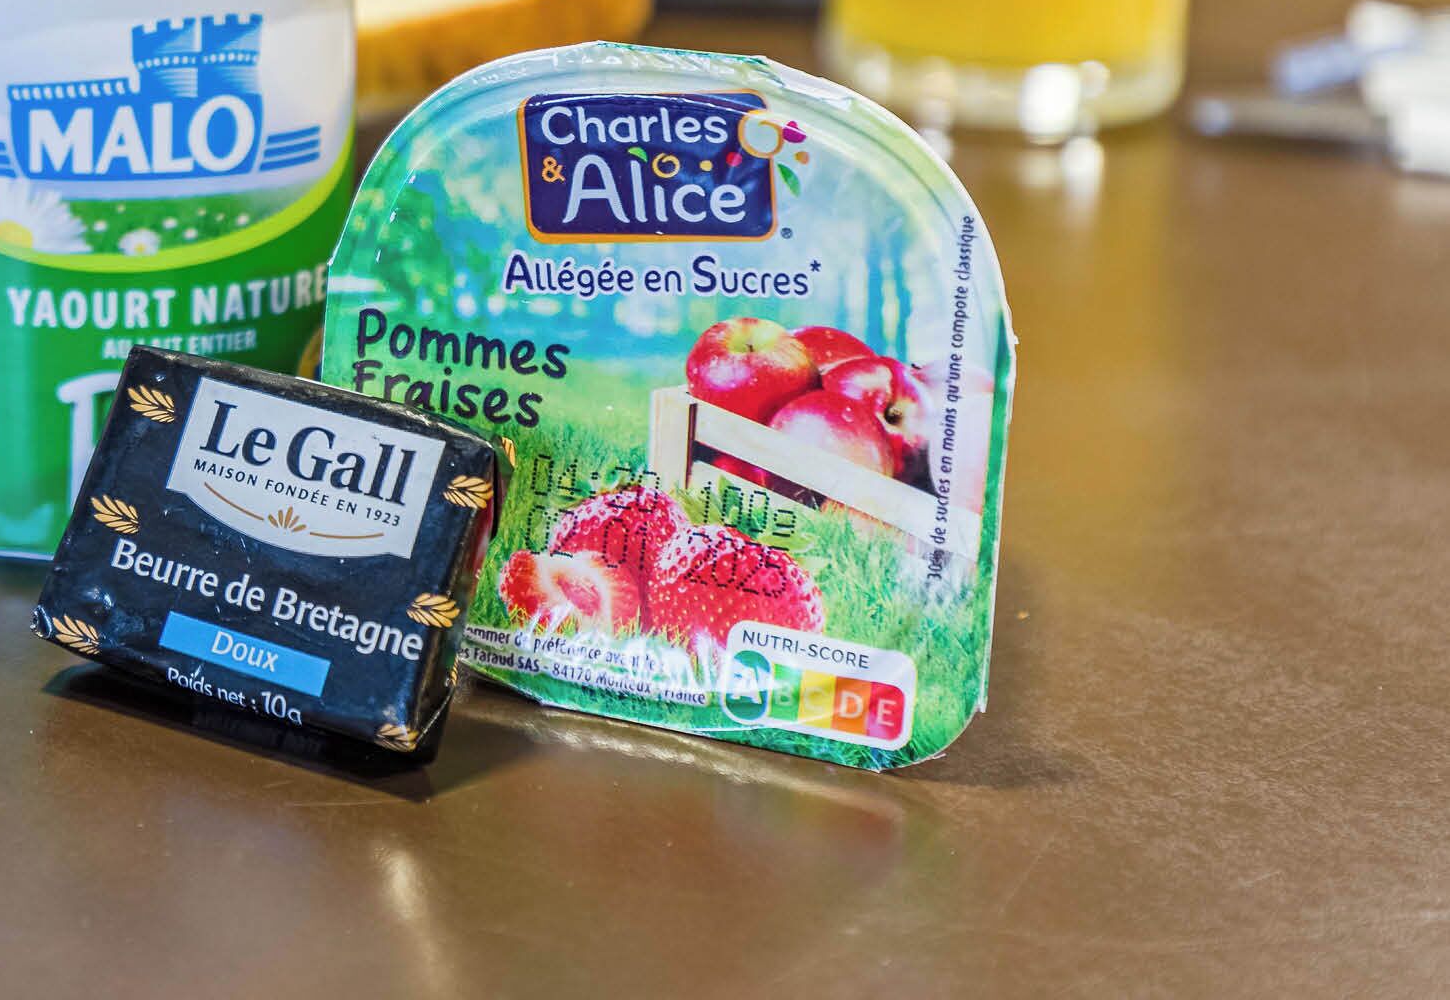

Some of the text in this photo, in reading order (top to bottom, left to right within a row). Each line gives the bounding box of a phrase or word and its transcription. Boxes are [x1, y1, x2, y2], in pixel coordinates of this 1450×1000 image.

[28, 95, 255, 176] MALO
[540, 106, 729, 146] Charles
[541, 152, 747, 224] & Alice
[952, 215, 979, 281] classique
[5, 262, 328, 330] YAOURT NATURE
[504, 253, 634, 298] Allégée
[644, 268, 683, 293] en
[950, 285, 971, 348] compote
[102, 336, 133, 360] AU
[187, 328, 257, 357] ENTIER
[357, 308, 571, 379] Pommes
[352, 359, 543, 428] Fraises
[944, 353, 963, 402] qu'une
[940, 407, 958, 450] moins
[199, 400, 278, 467] Le
[285, 425, 417, 507] Gall
[938, 455, 953, 473] en
[193, 457, 402, 528] MAISON FONDÉE EN 1923
[934, 478, 951, 522] sucres
[929, 526, 946, 544] de
[110, 537, 425, 662] Beurre de Bretagne
[210, 630, 280, 674] Doux
[474, 647, 515, 669] Faraud
[517, 655, 541, 673] SAS
[742, 629, 871, 670] NUTRI-SCORE
[167, 667, 214, 697] Poids
[217, 686, 248, 709] net
[838, 690, 864, 720] D
[876, 698, 897, 727] E
